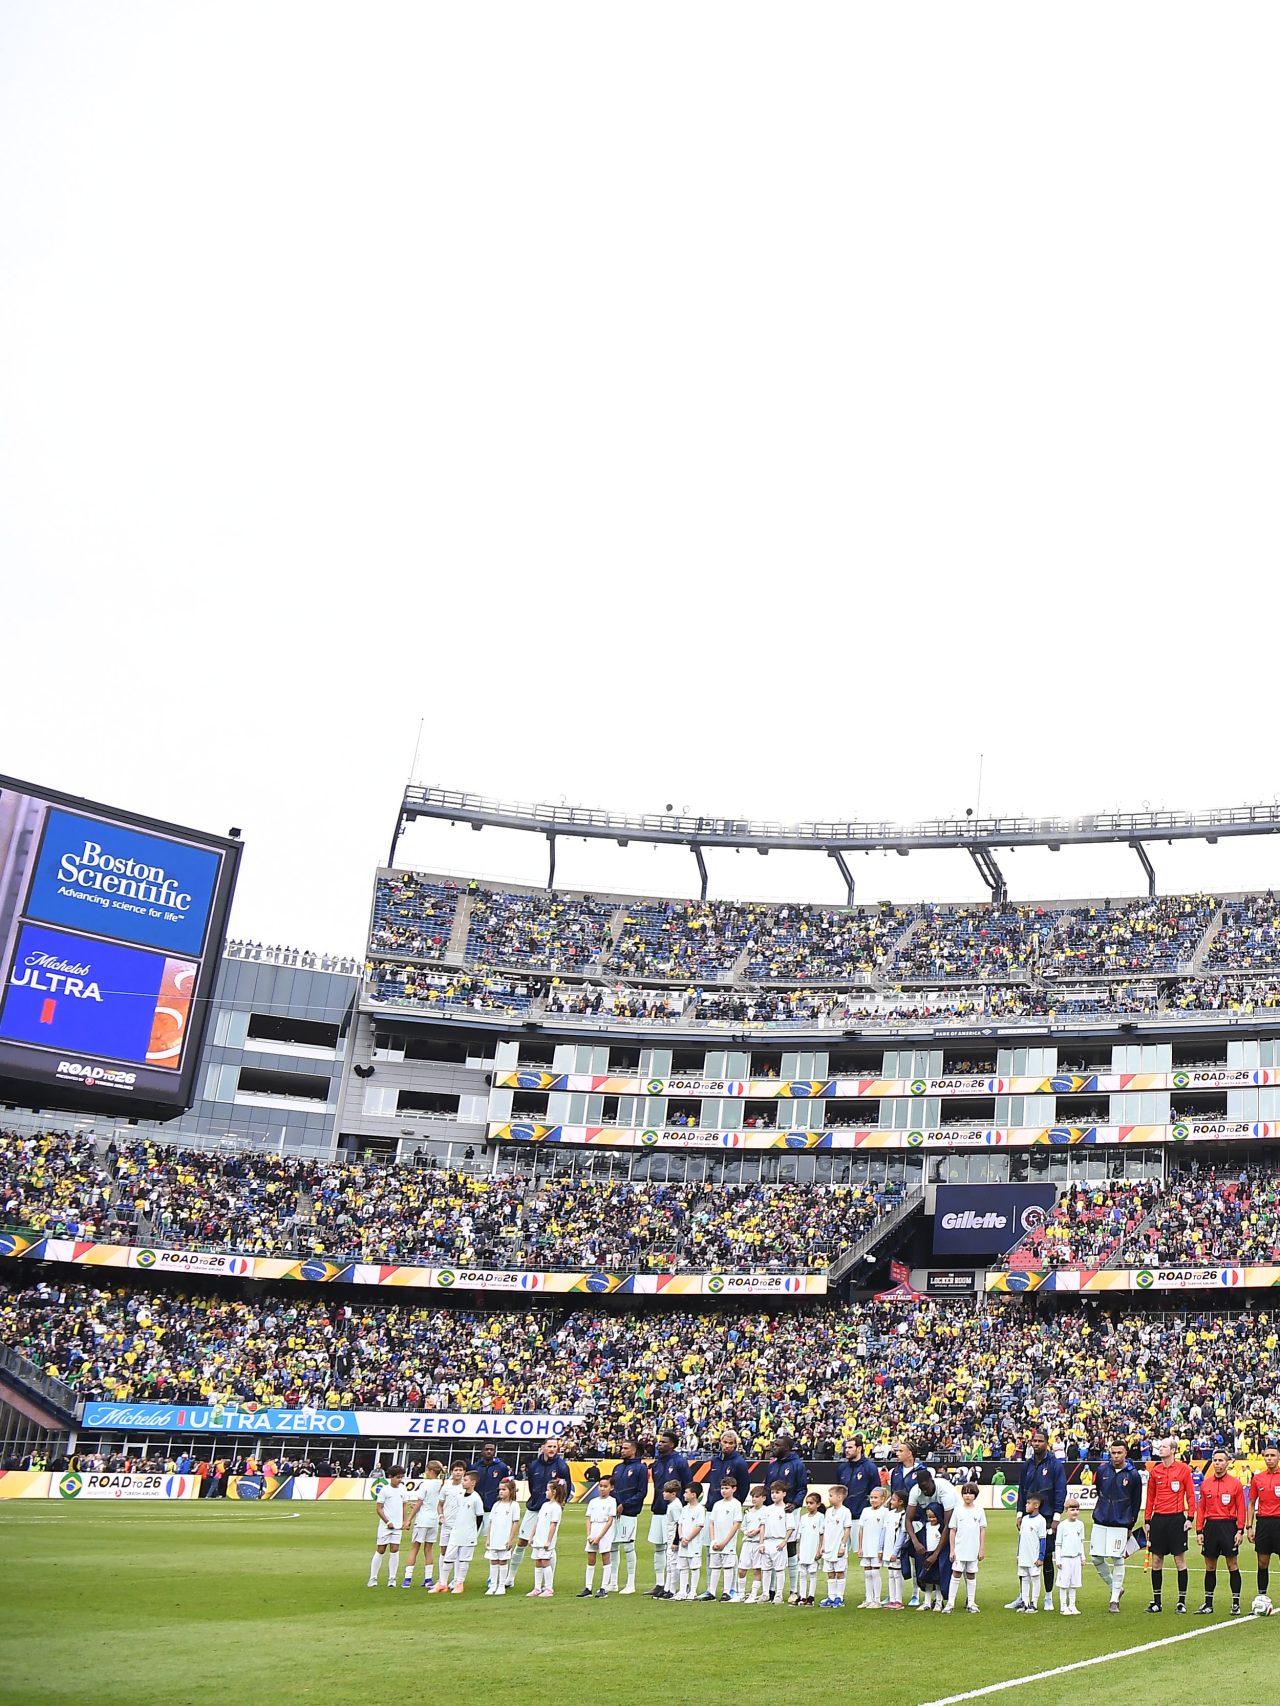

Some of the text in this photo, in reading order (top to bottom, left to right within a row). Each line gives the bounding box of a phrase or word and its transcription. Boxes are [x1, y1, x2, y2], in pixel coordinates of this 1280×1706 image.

[80, 841, 164, 884] Boston
[57, 853, 191, 911] Scientific
[57, 886, 109, 908] Advancing
[112, 899, 147, 915] science
[149, 908, 162, 918] for
[24, 951, 91, 976] Michelob
[10, 965, 102, 1002] ULTRA
[57, 1061, 136, 1084] ROAD TO 26
[1193, 1072, 1226, 1081] ROAD
[1235, 1072, 1250, 1080] 26
[668, 1081, 700, 1089] ROAD
[710, 1082, 724, 1090] 26
[930, 1080, 962, 1089] ROAD
[971, 1080, 985, 1088] 26
[1193, 1125, 1226, 1133] ROAD
[1235, 1124, 1250, 1132] 26
[662, 1132, 696, 1140] ROAD
[705, 1132, 720, 1141] 26
[928, 1131, 959, 1140] ROAD
[968, 1131, 983, 1139] 26
[942, 1211, 1006, 1229] Gillette
[161, 1253, 199, 1263] ROAD
[209, 1257, 226, 1266] 26
[459, 1273, 493, 1281] ROAD
[503, 1274, 518, 1282] 26
[728, 1278, 759, 1286] ROAD
[768, 1278, 782, 1286] 26
[1157, 1272, 1192, 1281] ROAD
[1202, 1271, 1218, 1279] 26
[88, 1408, 177, 1426] Michelob
[276, 1413, 345, 1432] ZERO
[409, 1418, 573, 1435] ZERO ALCOHO
[88, 1476, 132, 1488] ROAD
[143, 1477, 163, 1488] 26
[1080, 1488, 1098, 1499] 26
